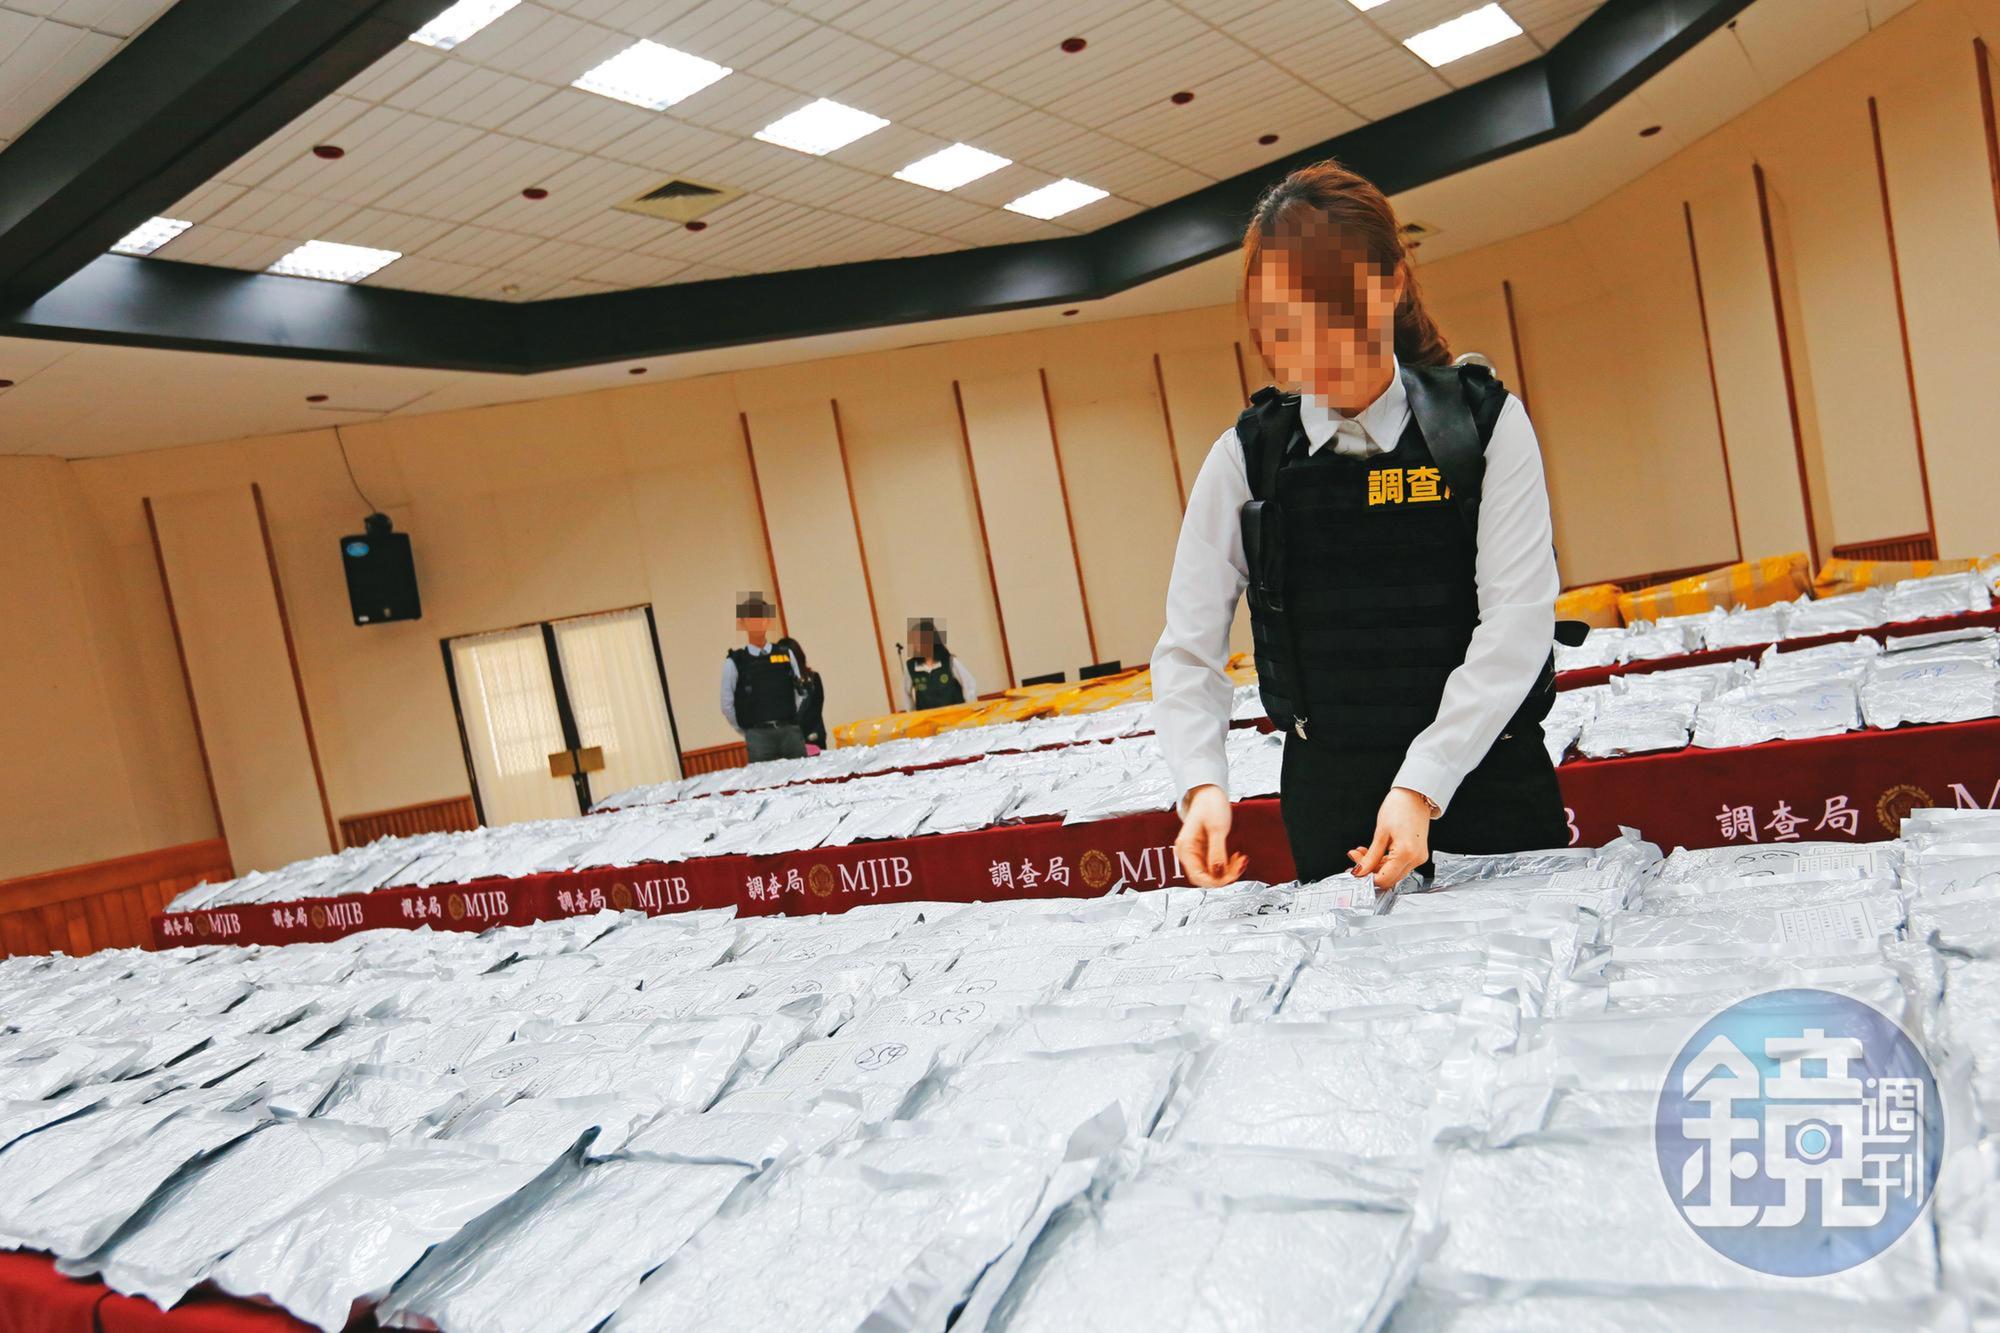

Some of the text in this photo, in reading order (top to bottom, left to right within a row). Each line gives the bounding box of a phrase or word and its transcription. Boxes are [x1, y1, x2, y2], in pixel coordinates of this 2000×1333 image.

[1367, 465, 1451, 506] 調查
[1716, 795, 1860, 842] 調查局
[746, 857, 913, 901] 調查局 MJIB
[988, 846, 1186, 889] 調查局 MJI
[401, 891, 508, 920] 調查局 MJIB
[557, 877, 691, 912] 調查局 MJIB
[209, 914, 241, 937] MJIB
[324, 904, 363, 931] MJIB
